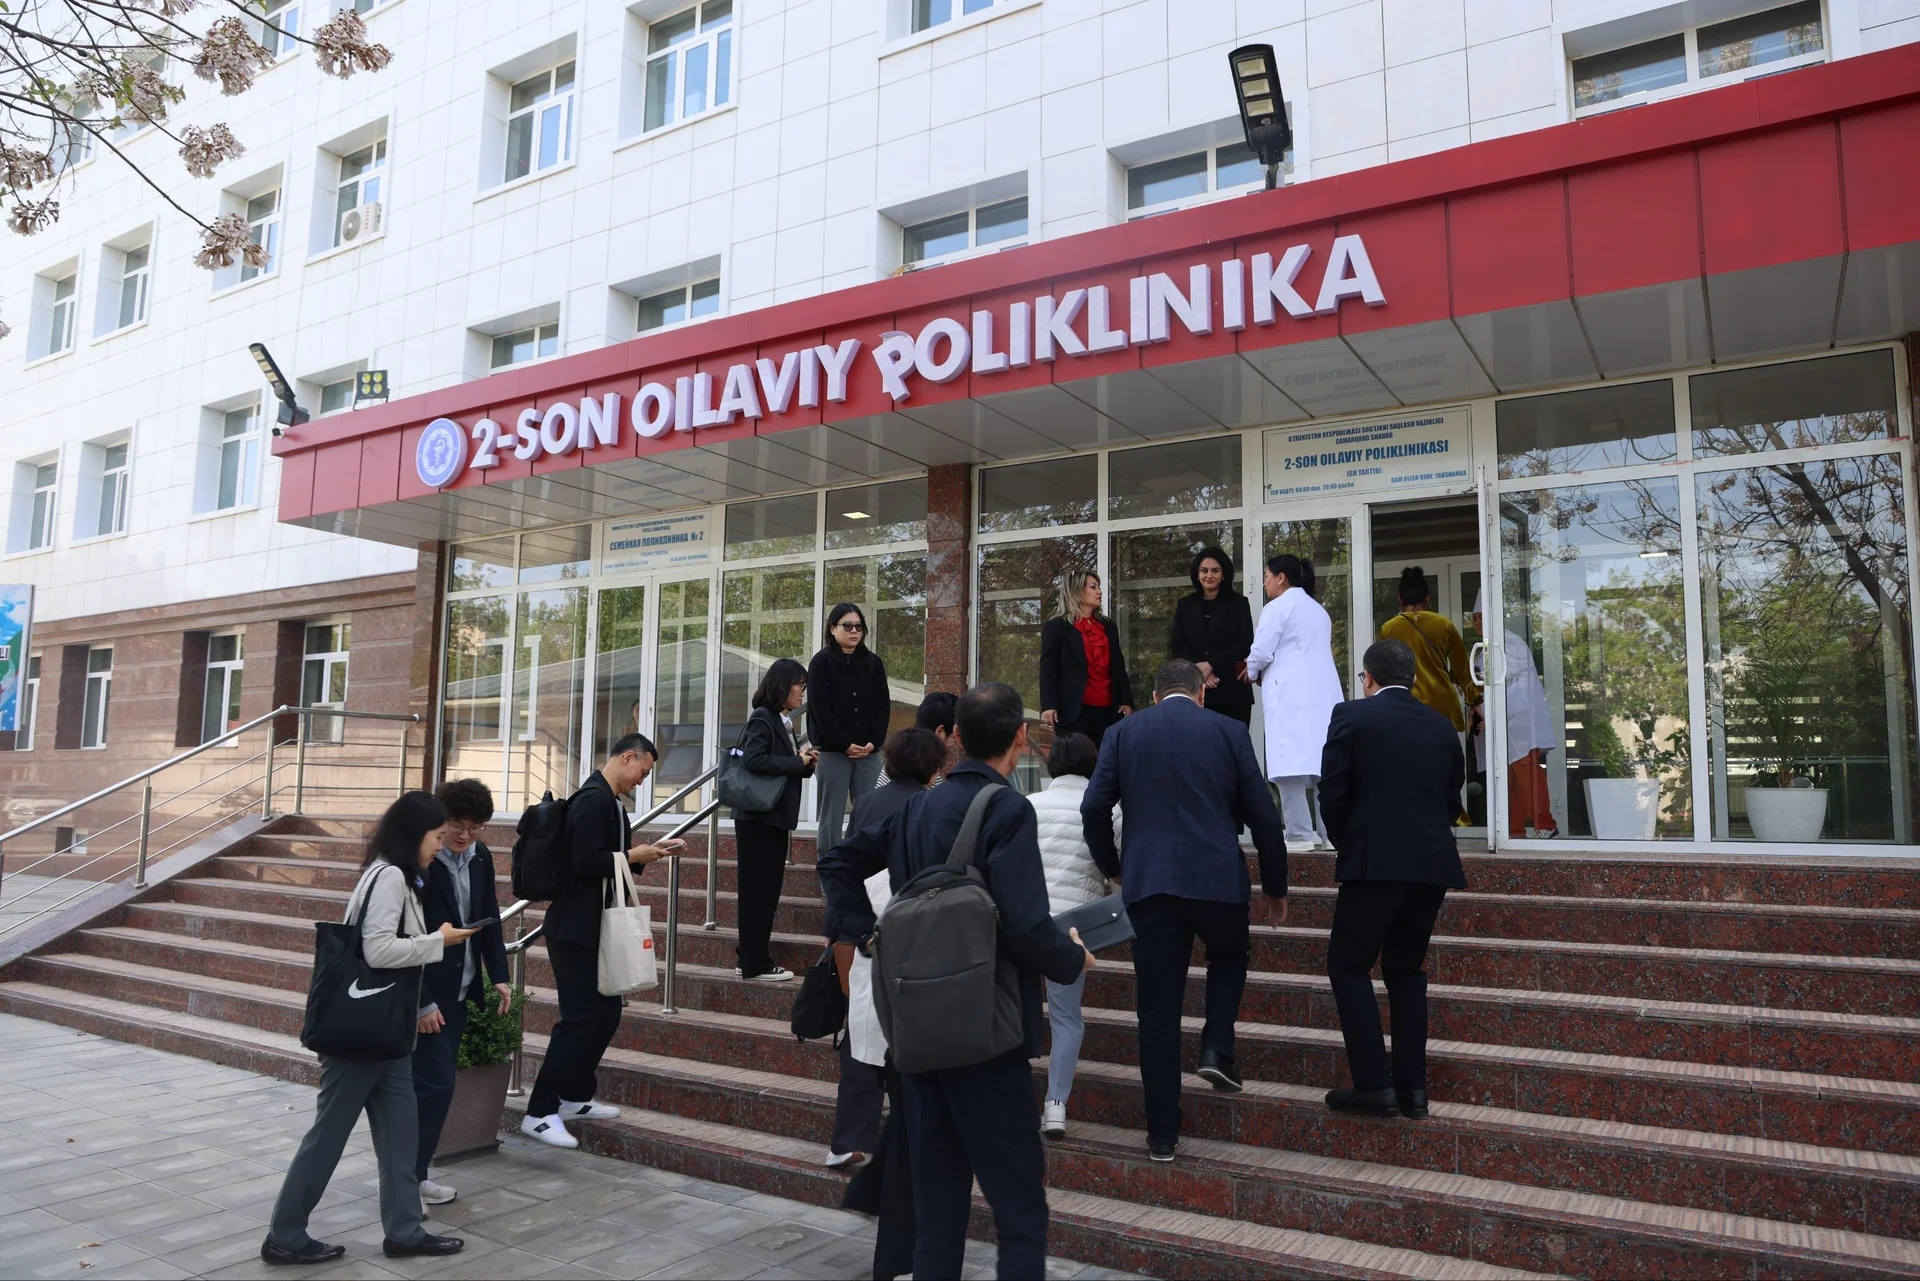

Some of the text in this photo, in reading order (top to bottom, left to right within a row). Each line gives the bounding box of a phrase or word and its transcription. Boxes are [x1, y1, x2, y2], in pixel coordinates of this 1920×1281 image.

[470, 392, 621, 471] 2-SON
[631, 338, 863, 439] OILAVIY
[872, 233, 1388, 403] POLIKLINIKA
[1322, 427, 1361, 438] RESPUBLIKASI
[1389, 420, 1415, 430] SAQLASH
[1415, 417, 1444, 427] VAZIRLIGI
[1335, 431, 1394, 445] SAMARQAND SHAHAR
[1284, 439, 1449, 470] 2-SON OILAVIY POLIKLINIKASI
[1346, 469, 1357, 478] ISH
[610, 537, 640, 551] СЕМЕЙНАЯ
[642, 533, 688, 547] ПОЛИКЛИНИКА
[699, 531, 703, 540] 2
